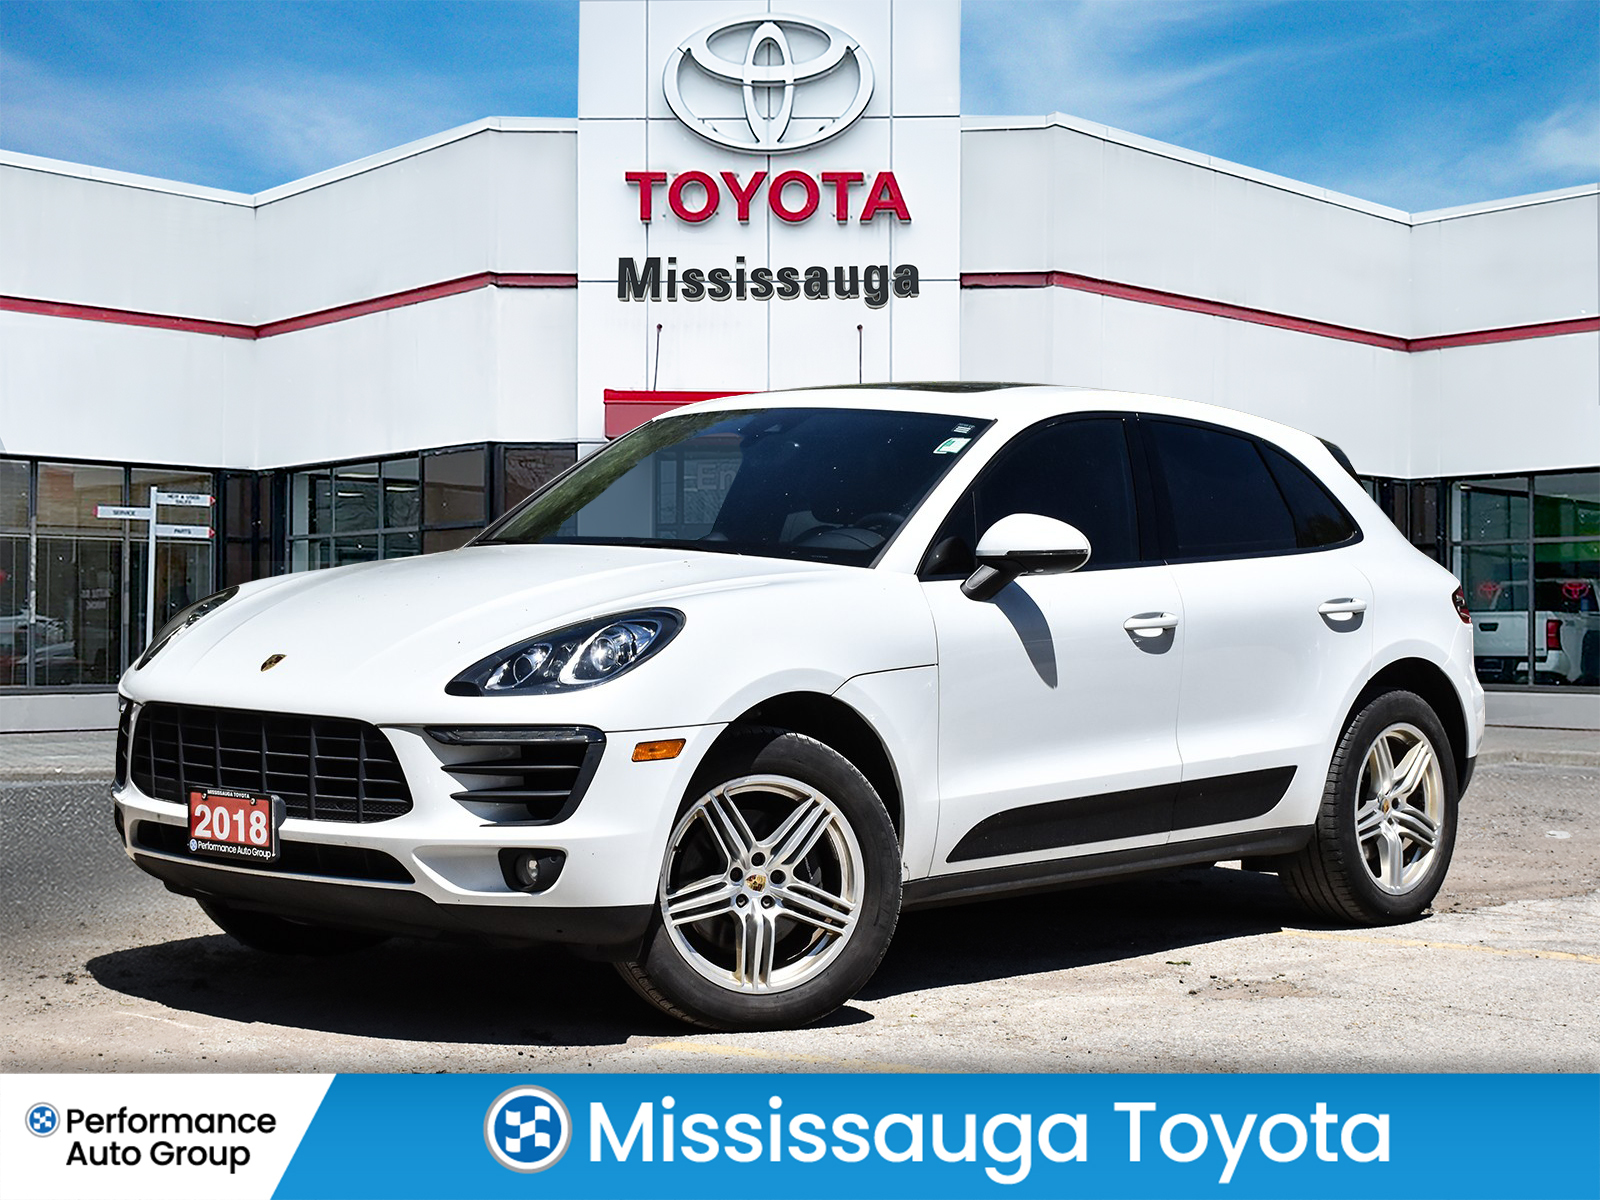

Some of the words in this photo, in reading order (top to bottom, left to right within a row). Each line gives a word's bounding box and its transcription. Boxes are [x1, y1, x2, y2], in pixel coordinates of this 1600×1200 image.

[625, 170, 912, 224] TOYOTA
[617, 256, 920, 309] Mississauga
[112, 509, 136, 517] SERVICE
[173, 527, 192, 535] PARTS
[207, 789, 234, 797] MISSISSAUGA
[194, 804, 268, 845] 2018
[198, 840, 237, 854] Performance
[237, 845, 252, 856] Auto
[251, 847, 272, 860] Group
